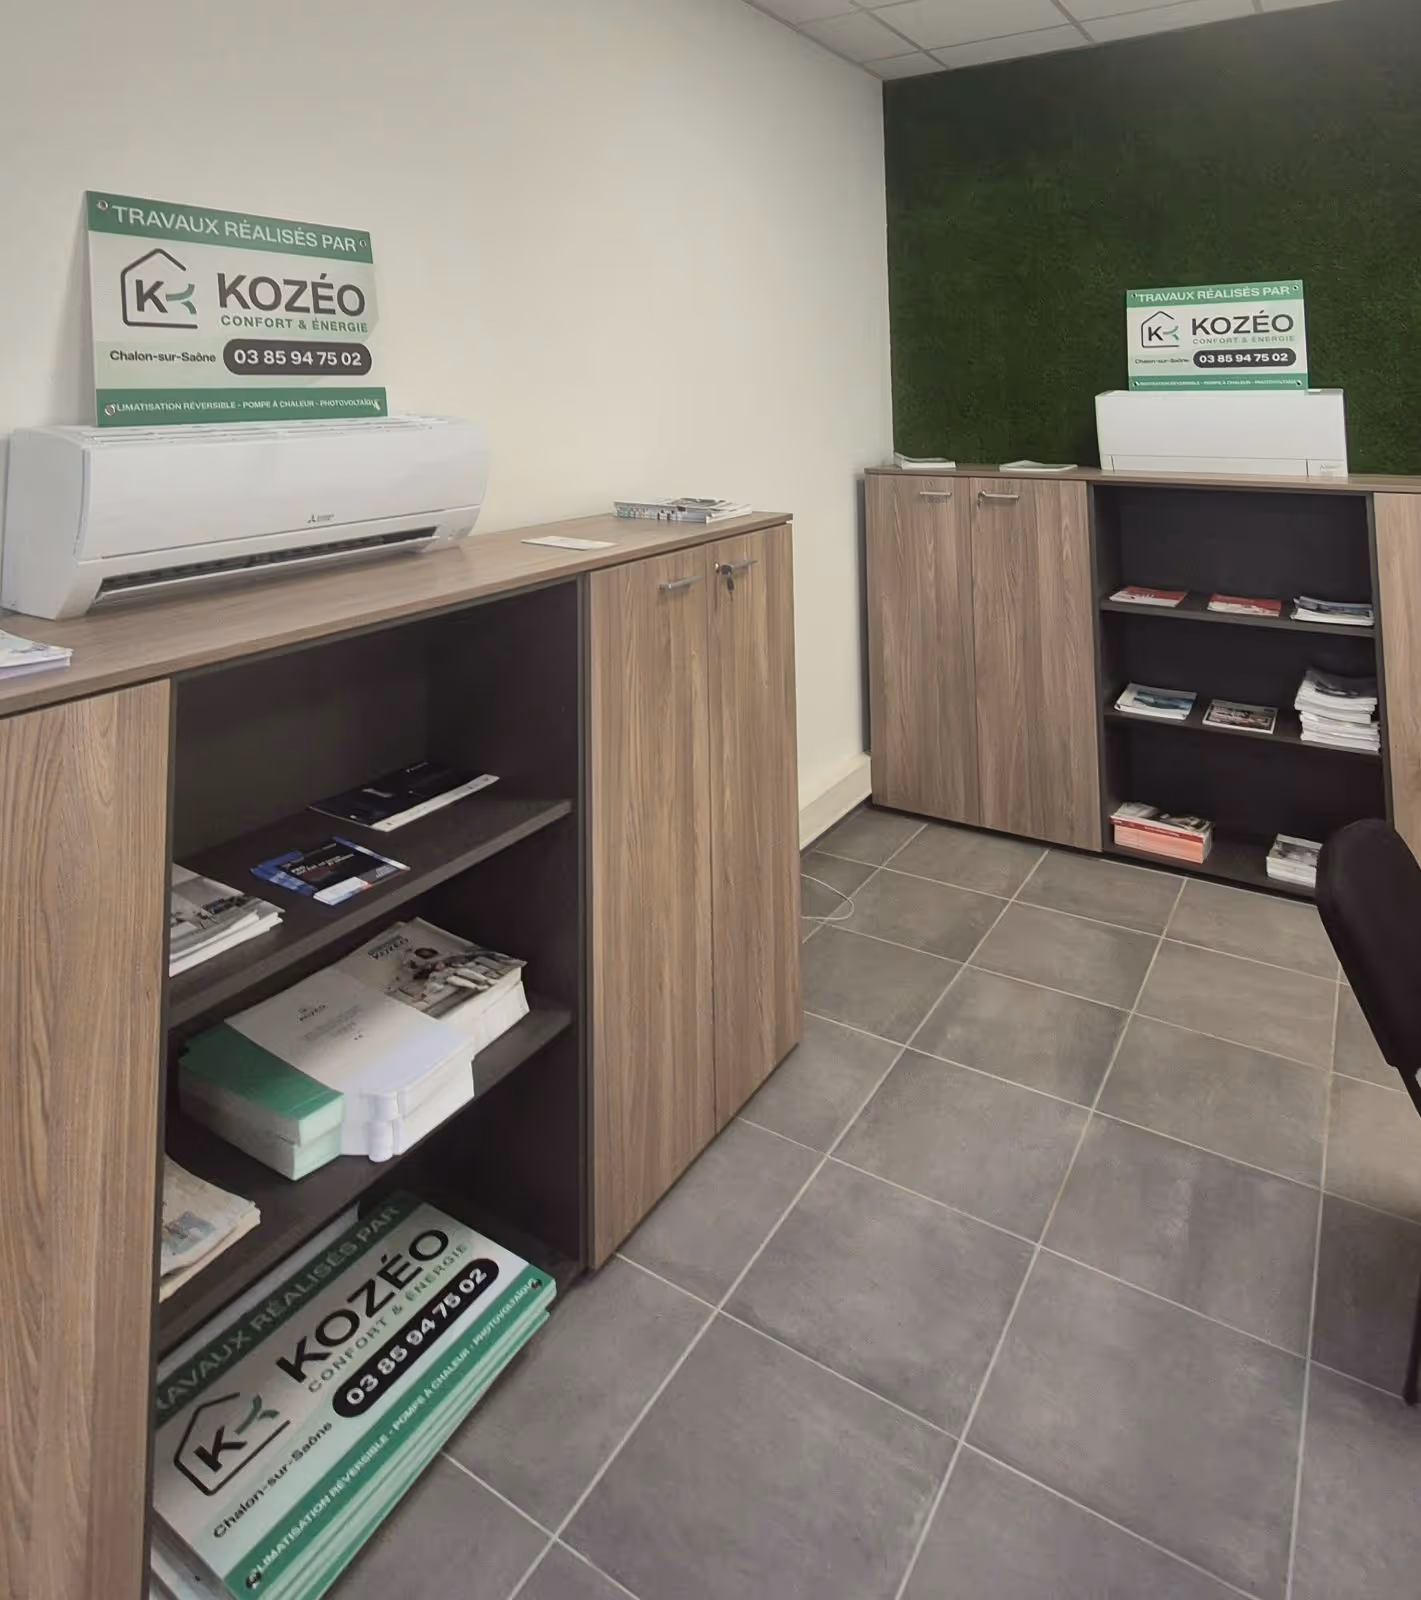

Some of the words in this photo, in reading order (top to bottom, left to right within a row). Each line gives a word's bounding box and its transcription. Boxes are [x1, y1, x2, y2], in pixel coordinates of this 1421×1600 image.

[112, 205, 220, 235] TRAVAUX
[224, 219, 318, 247] RÉALISÉS
[322, 235, 357, 253] PAR
[217, 272, 365, 317] KOZÉO
[1138, 291, 1195, 302] TRAVAUX
[1197, 286, 1260, 299] RÉALISÉS
[1262, 286, 1290, 296] PAR
[220, 315, 293, 330] CONFORT
[298, 319, 307, 330] &
[312, 317, 368, 333] ÉNERGIE
[1191, 309, 1294, 336] KOZÉO
[110, 350, 216, 363] Chalon-sur-Saône
[234, 349, 259, 365] 03
[263, 350, 287, 365] 85
[291, 350, 314, 366] 94
[316, 350, 338, 366] 75
[341, 351, 362, 366] 02
[1192, 337, 1238, 345] CONFORT
[1199, 355, 1215, 364] 03
[1217, 354, 1233, 363] 85
[1235, 354, 1252, 363] 94
[1254, 353, 1270, 362] 75
[1272, 353, 1289, 362] 02
[183, 400, 236, 410] RÉVERSIBLE
[242, 401, 271, 409] POMPE
[280, 400, 314, 408] CHALEUR
[250, 1241, 359, 1332] RÉALISÉS
[355, 1205, 401, 1242] PAR
[276, 1229, 449, 1383] KOZÉO
[308, 1317, 388, 1393] CONFORT
[391, 1304, 404, 1317] &
[404, 1244, 468, 1302] ÉNERGIE
[346, 1374, 379, 1405] 03
[377, 1345, 408, 1375] 85
[405, 1318, 436, 1346] 94
[431, 1292, 461, 1319] 75
[458, 1268, 488, 1294] 02
[329, 1433, 391, 1498] RÉVERSIBLE
[392, 1396, 426, 1431] POMPE
[430, 1348, 471, 1390] CHALEUR
[213, 1421, 333, 1538] Chalon-sur-Saône
